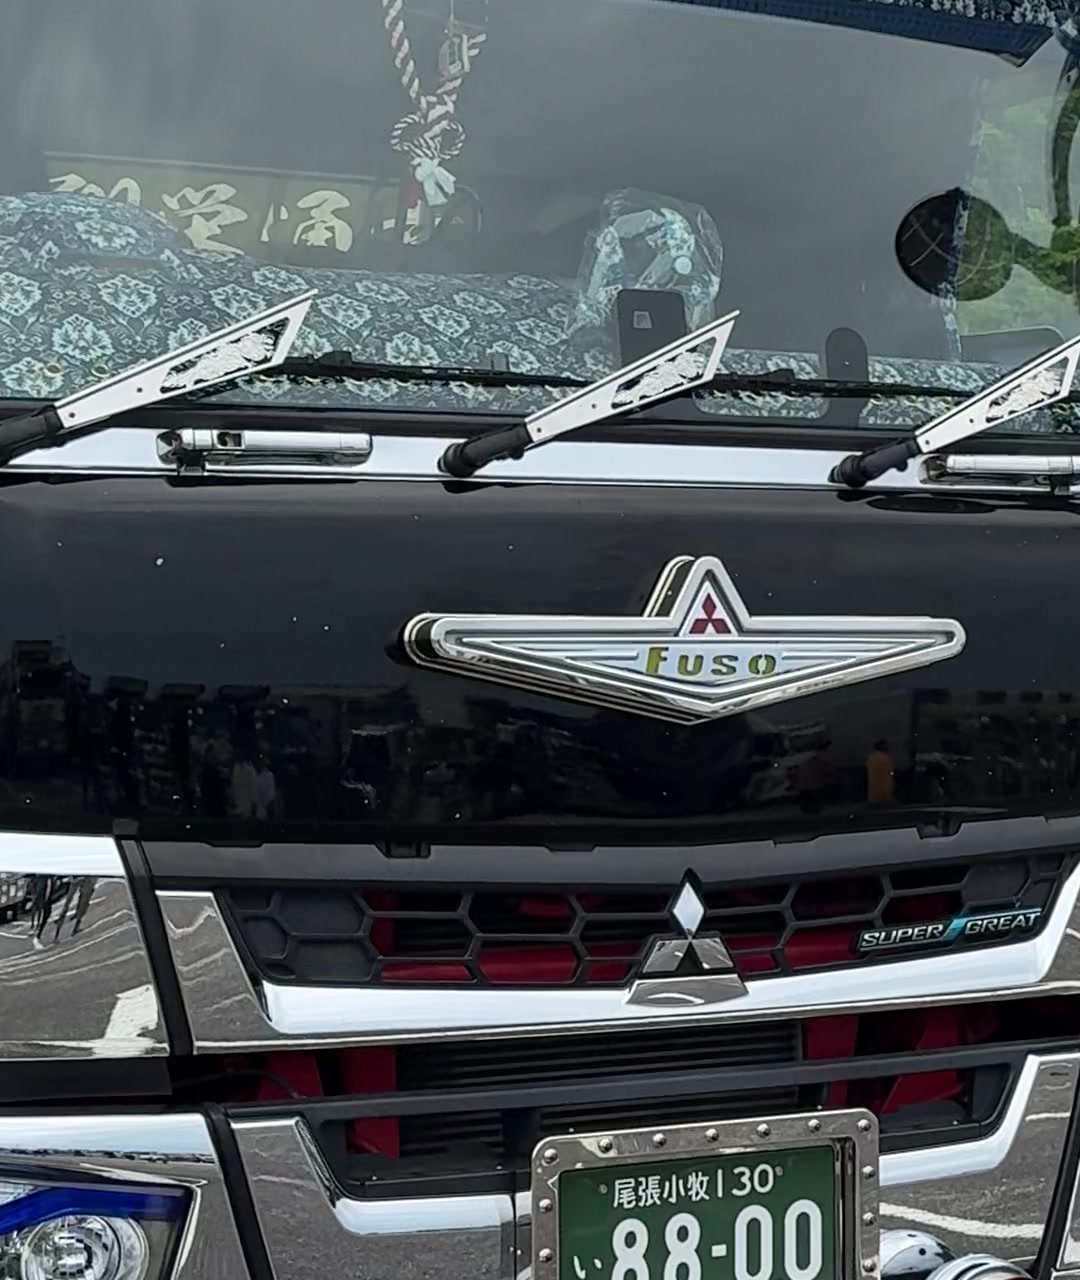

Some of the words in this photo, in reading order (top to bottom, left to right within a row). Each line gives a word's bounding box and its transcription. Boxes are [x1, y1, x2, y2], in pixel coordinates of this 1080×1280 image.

[645, 646, 777, 677] FUSO
[861, 923, 944, 948] SUPER
[964, 912, 1041, 936] GREAT
